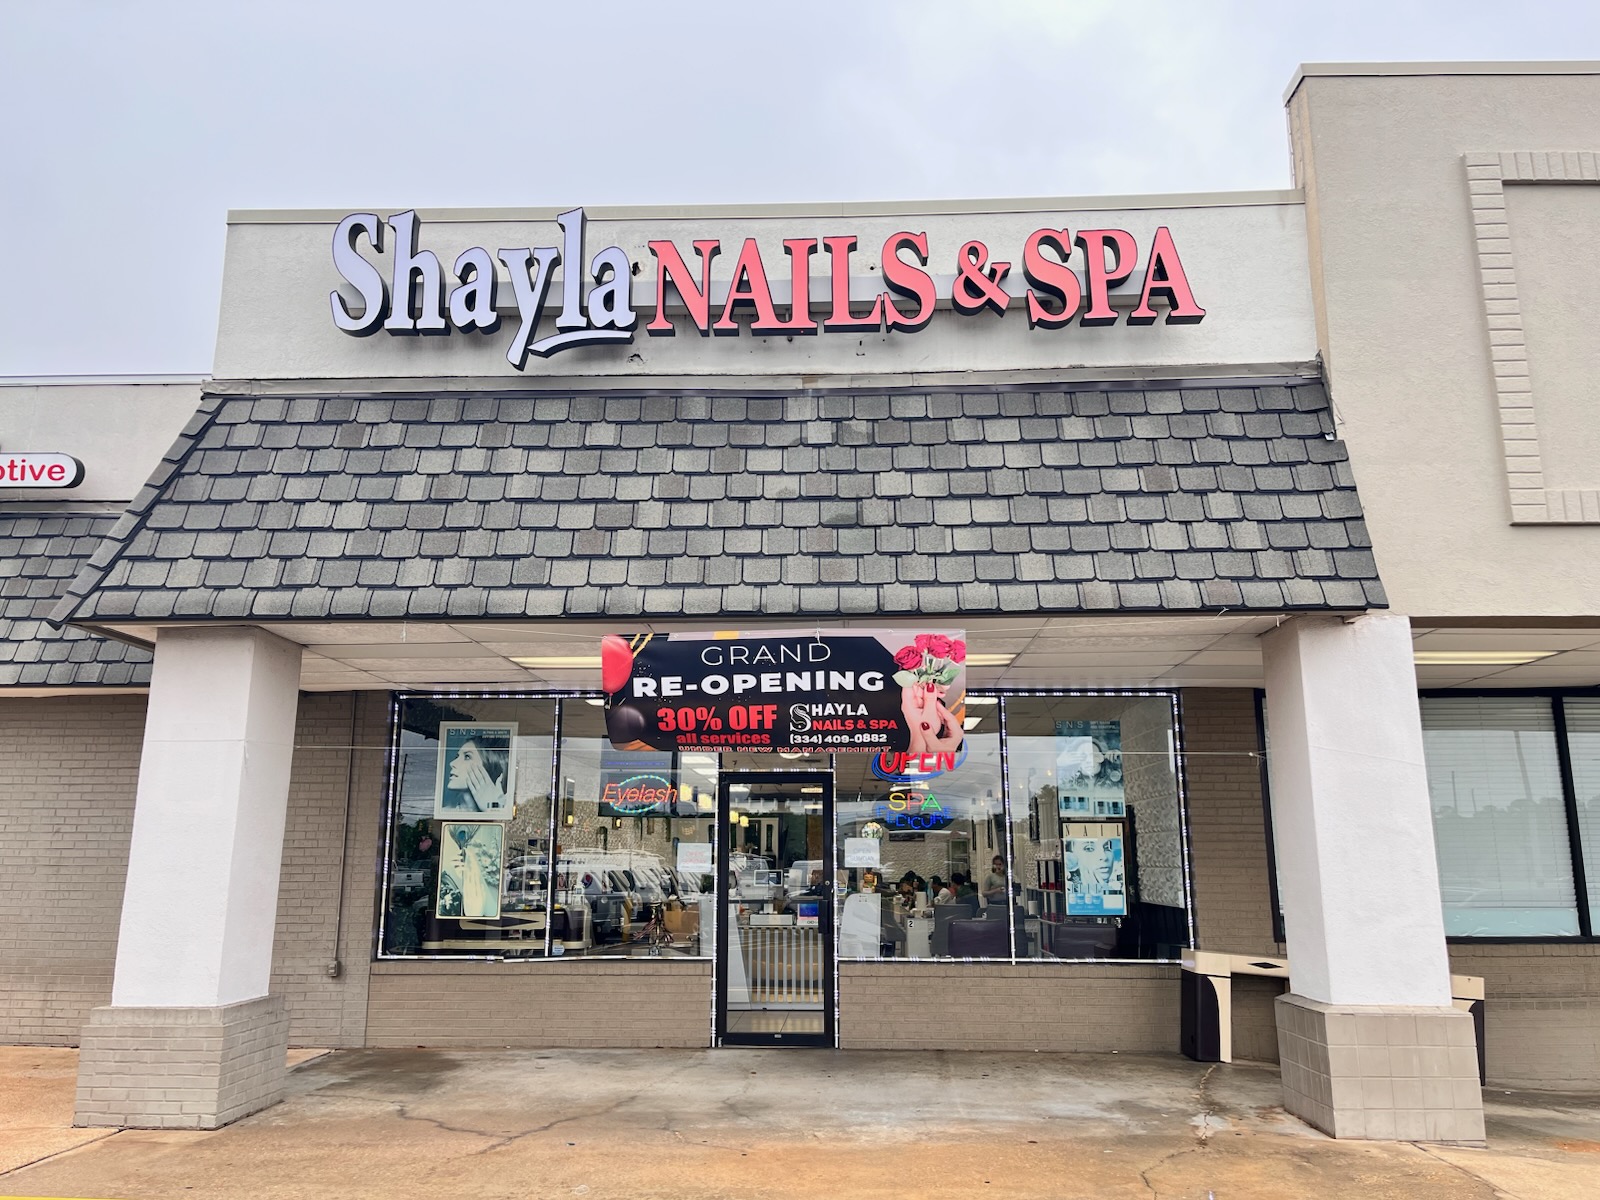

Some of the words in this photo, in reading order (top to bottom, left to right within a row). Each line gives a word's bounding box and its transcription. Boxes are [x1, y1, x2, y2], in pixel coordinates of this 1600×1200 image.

[330, 207, 637, 371] Shayla
[646, 231, 936, 336] NAILS
[952, 240, 1012, 318] &
[1022, 226, 1206, 330] SPA
[701, 643, 831, 666] GRAND
[632, 669, 884, 698] RE-OPENING
[657, 705, 722, 732] 30%
[729, 704, 778, 731] OFF
[812, 719, 855, 731] NAILS
[856, 719, 867, 730] &
[869, 719, 898, 730] SPA
[676, 733, 698, 744] all
[700, 732, 771, 744] services
[789, 734, 822, 744] (334)
[824, 733, 887, 744] 409-0882
[602, 783, 678, 806] Eyelash
[888, 792, 942, 811] SPA
